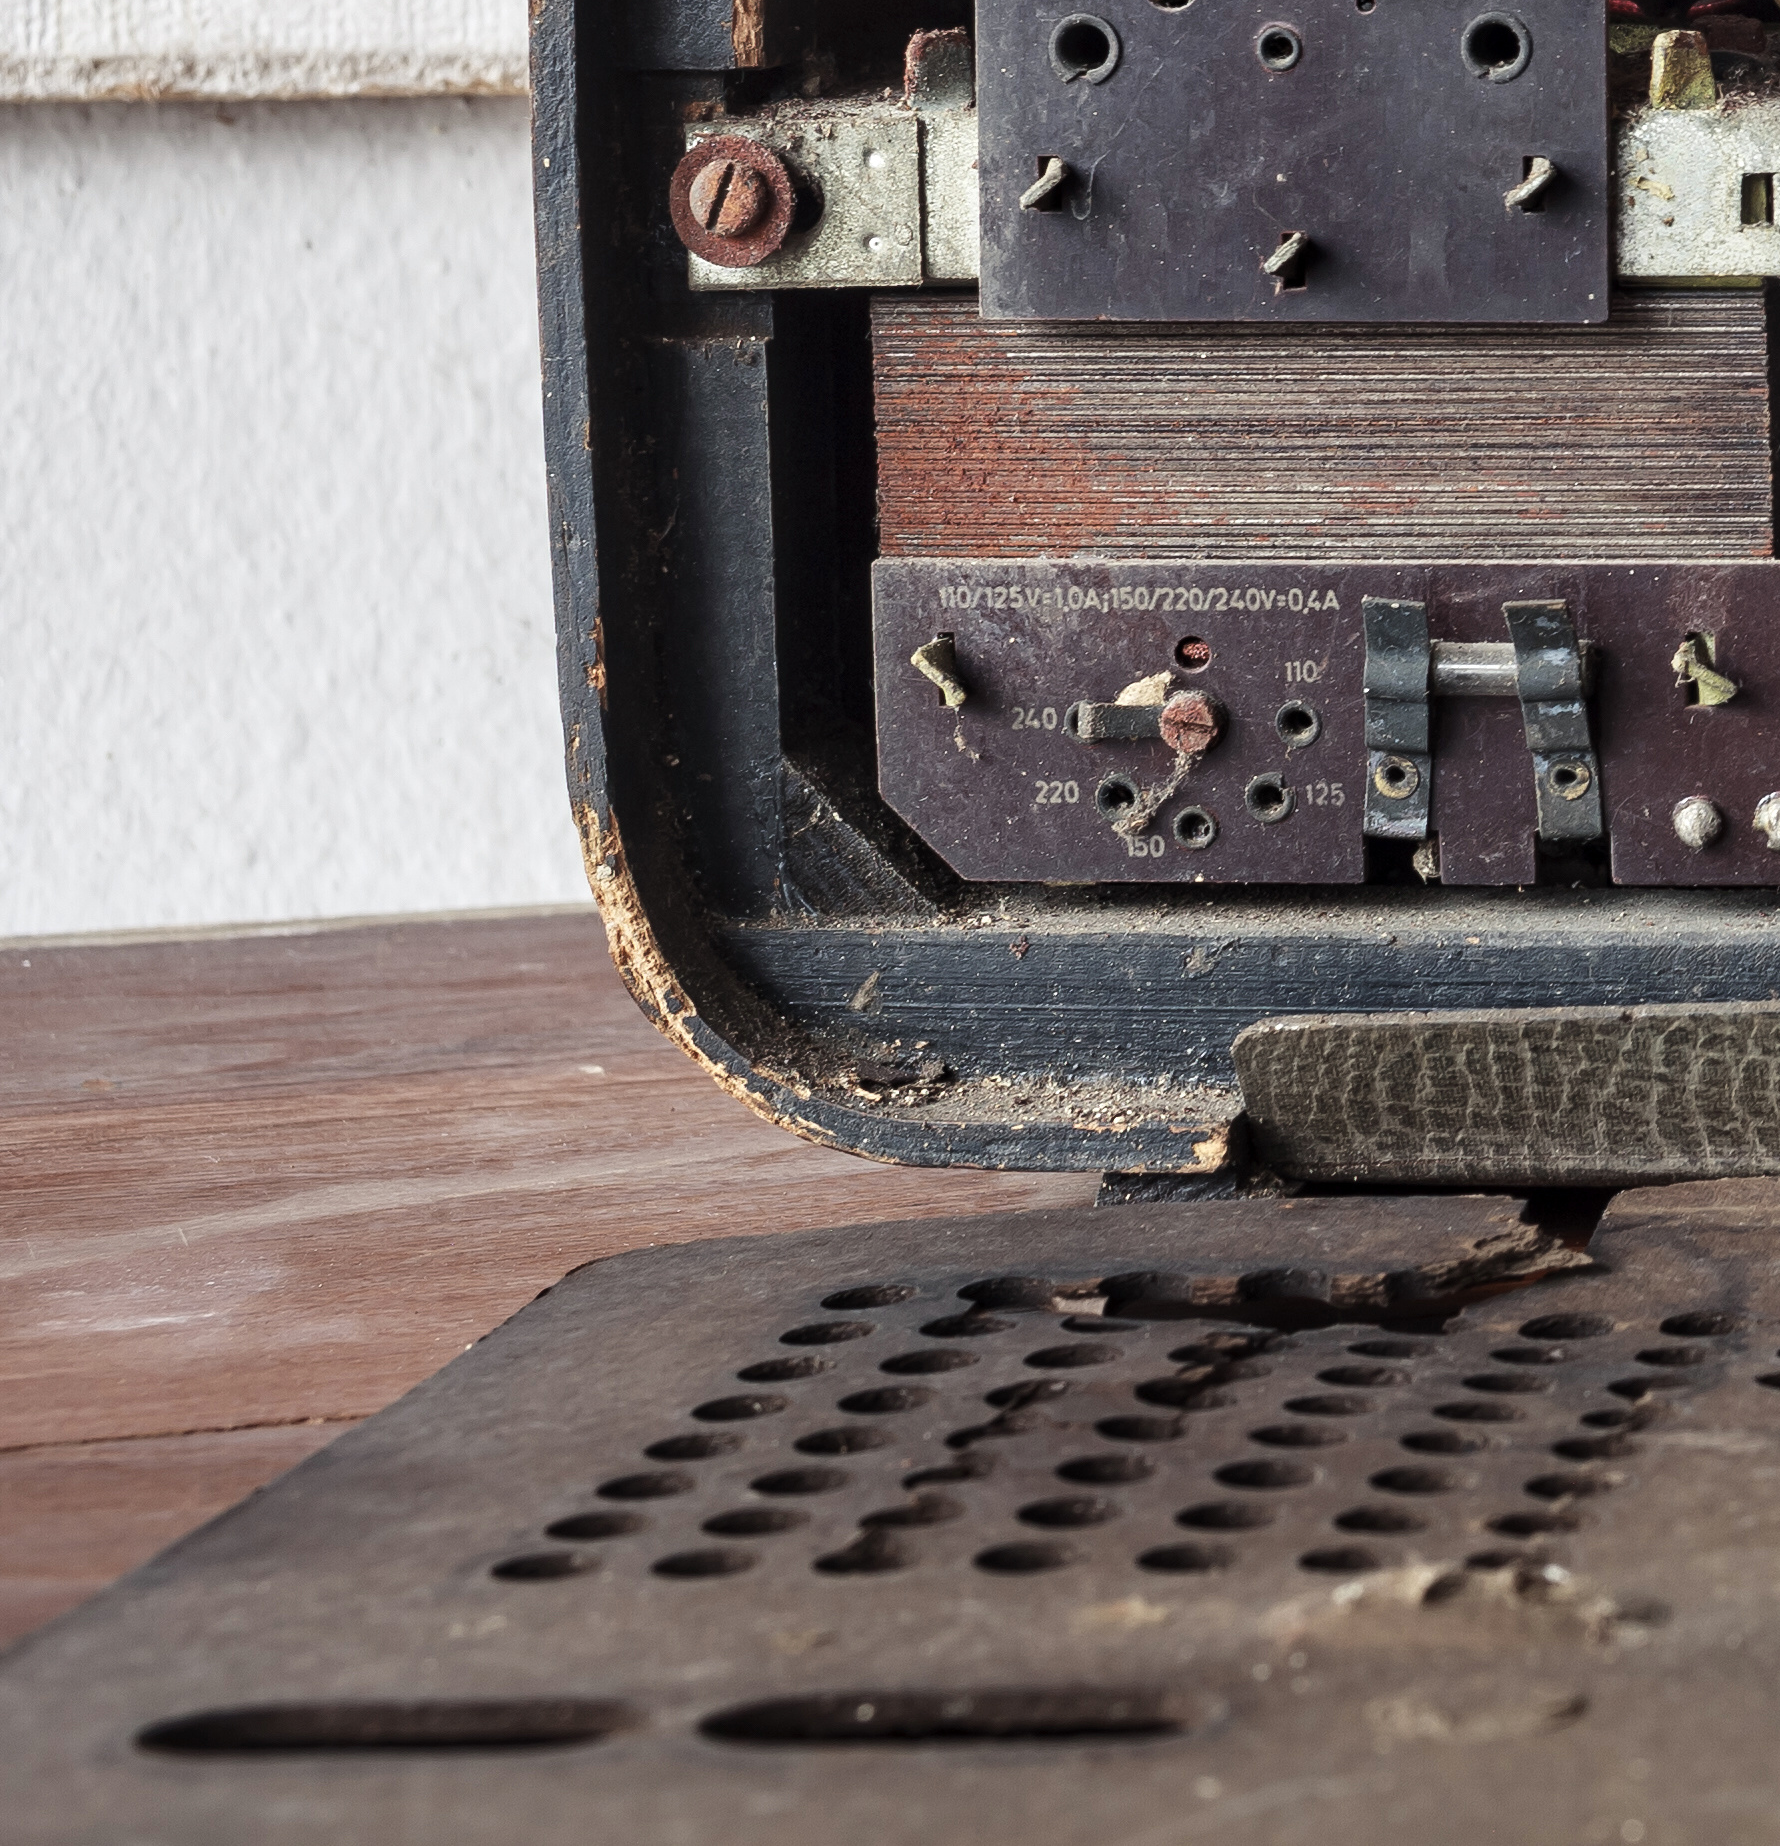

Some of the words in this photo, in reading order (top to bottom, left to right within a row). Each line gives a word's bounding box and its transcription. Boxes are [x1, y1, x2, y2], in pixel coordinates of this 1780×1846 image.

[1284, 659, 1318, 684] 110
[1011, 706, 1057, 731] 240
[1034, 780, 1080, 805] 220
[1305, 781, 1346, 807] 125
[1126, 834, 1166, 859] 150
